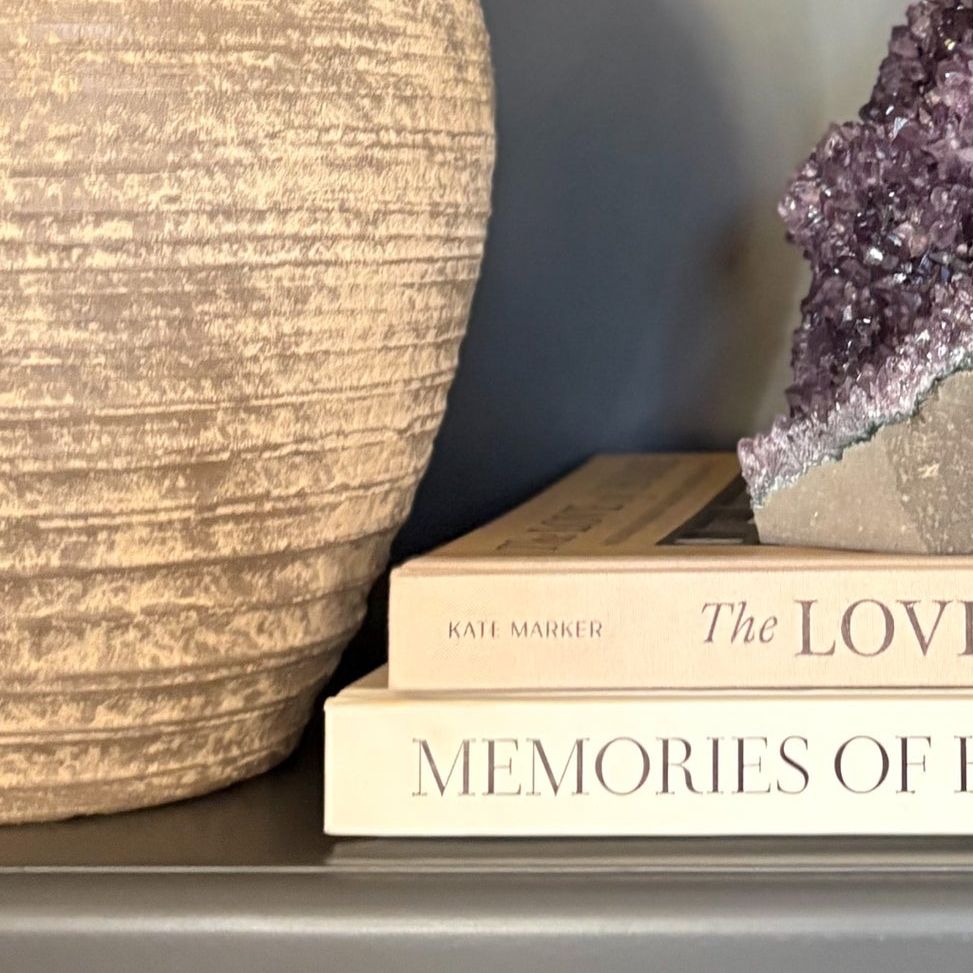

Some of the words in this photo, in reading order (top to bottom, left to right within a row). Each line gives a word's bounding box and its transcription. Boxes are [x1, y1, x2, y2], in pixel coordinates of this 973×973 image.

[448, 620, 499, 639] KATE
[511, 620, 603, 639] MARKER
[702, 601, 778, 645] The
[411, 735, 810, 797] MEMORIES
[834, 735, 932, 795] OF
